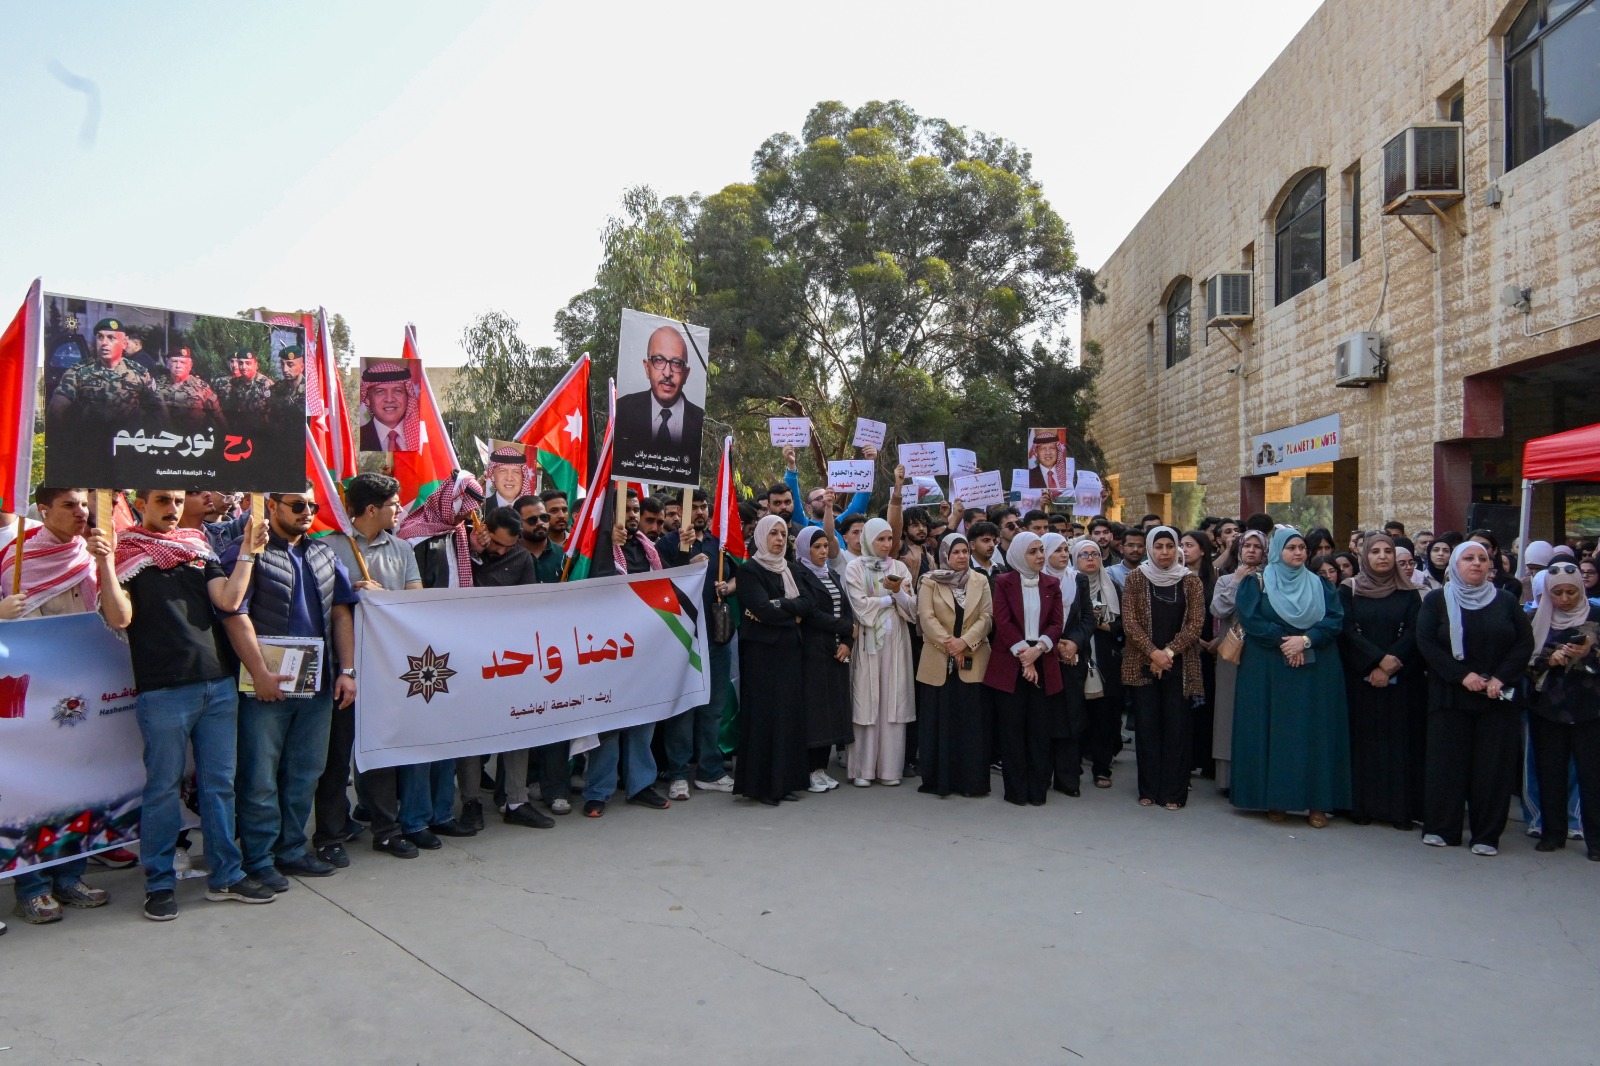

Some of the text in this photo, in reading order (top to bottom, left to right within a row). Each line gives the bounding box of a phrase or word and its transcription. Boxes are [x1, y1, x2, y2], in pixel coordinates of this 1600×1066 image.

[113, 426, 253, 462] رح نورجيهم
[1286, 432, 1337, 455] PLANET DONUTS
[830, 470, 872, 478] الرحمة والخلود
[856, 482, 870, 491] لروح
[481, 626, 636, 684] دمنا واحد
[101, 687, 138, 702] هاشمية
[551, 694, 585, 710] الجامعة
[594, 689, 612, 703] إرث
[510, 700, 549, 720] الهاشمية
